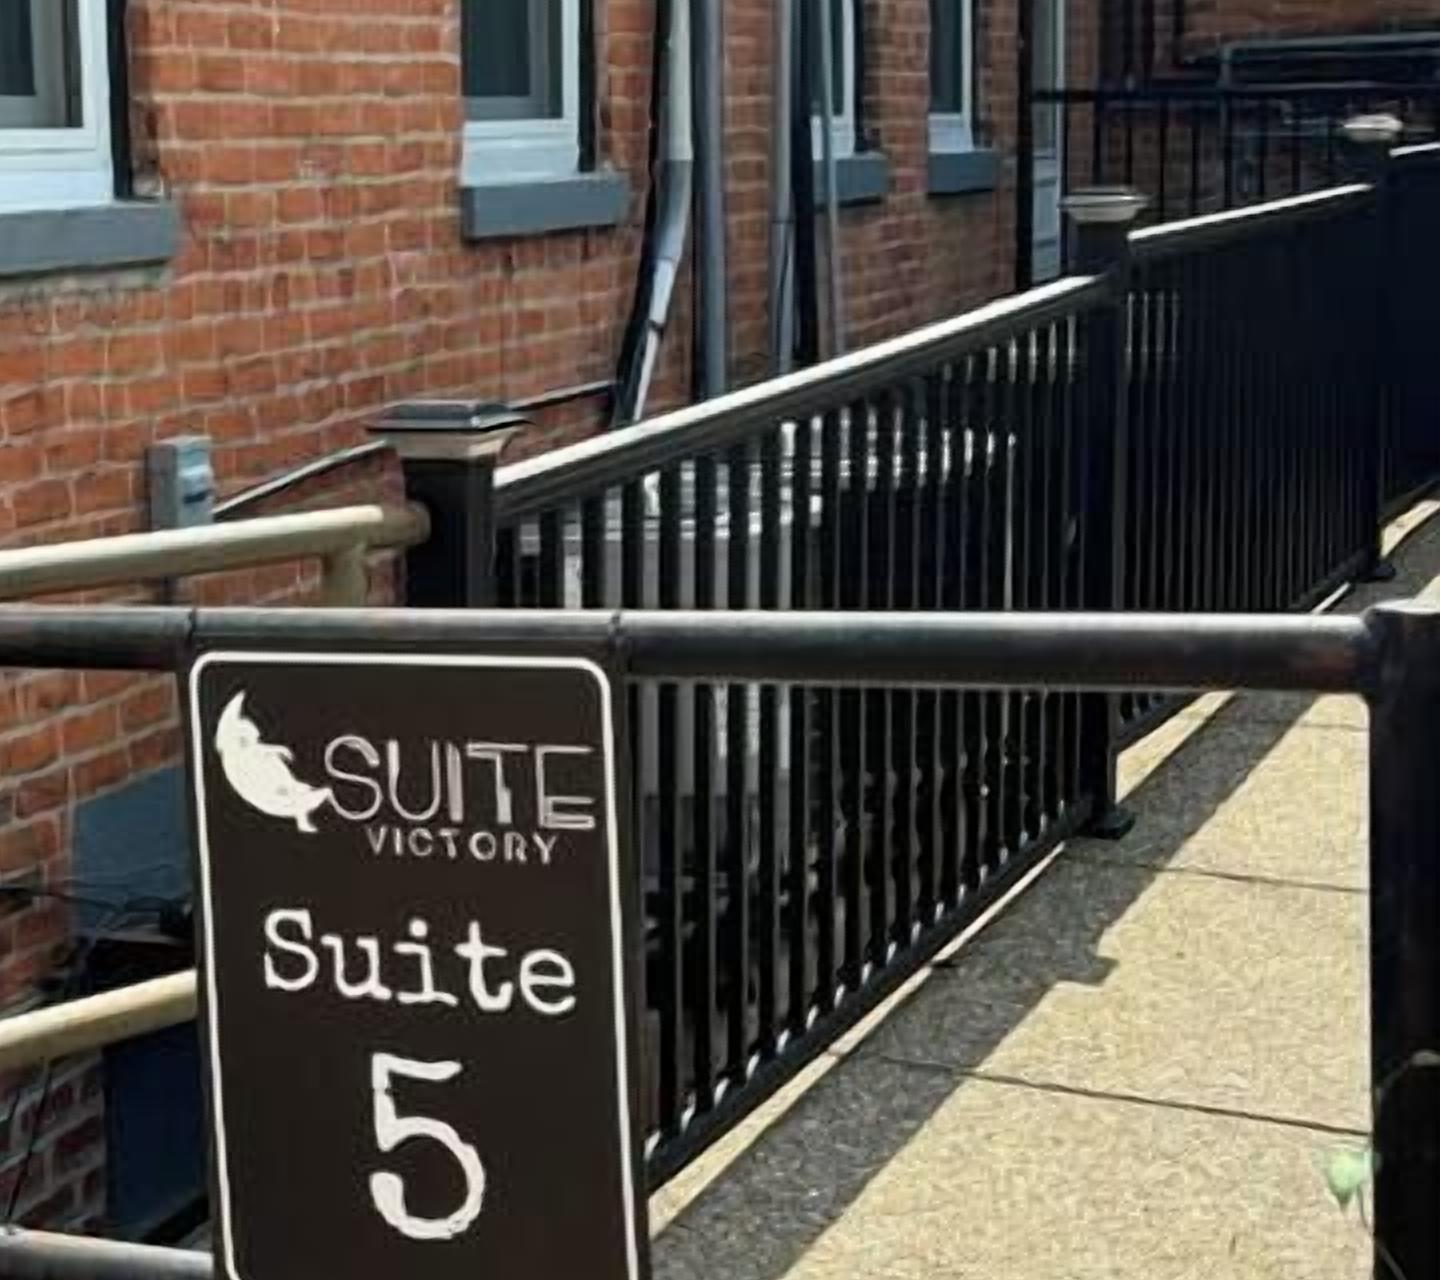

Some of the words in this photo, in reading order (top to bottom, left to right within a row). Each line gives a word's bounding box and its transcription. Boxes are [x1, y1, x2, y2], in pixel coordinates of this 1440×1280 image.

[323, 734, 596, 830] SUITE
[367, 824, 558, 864] VICTORY
[263, 907, 577, 1015] Suite
[367, 1051, 486, 1240] 5
